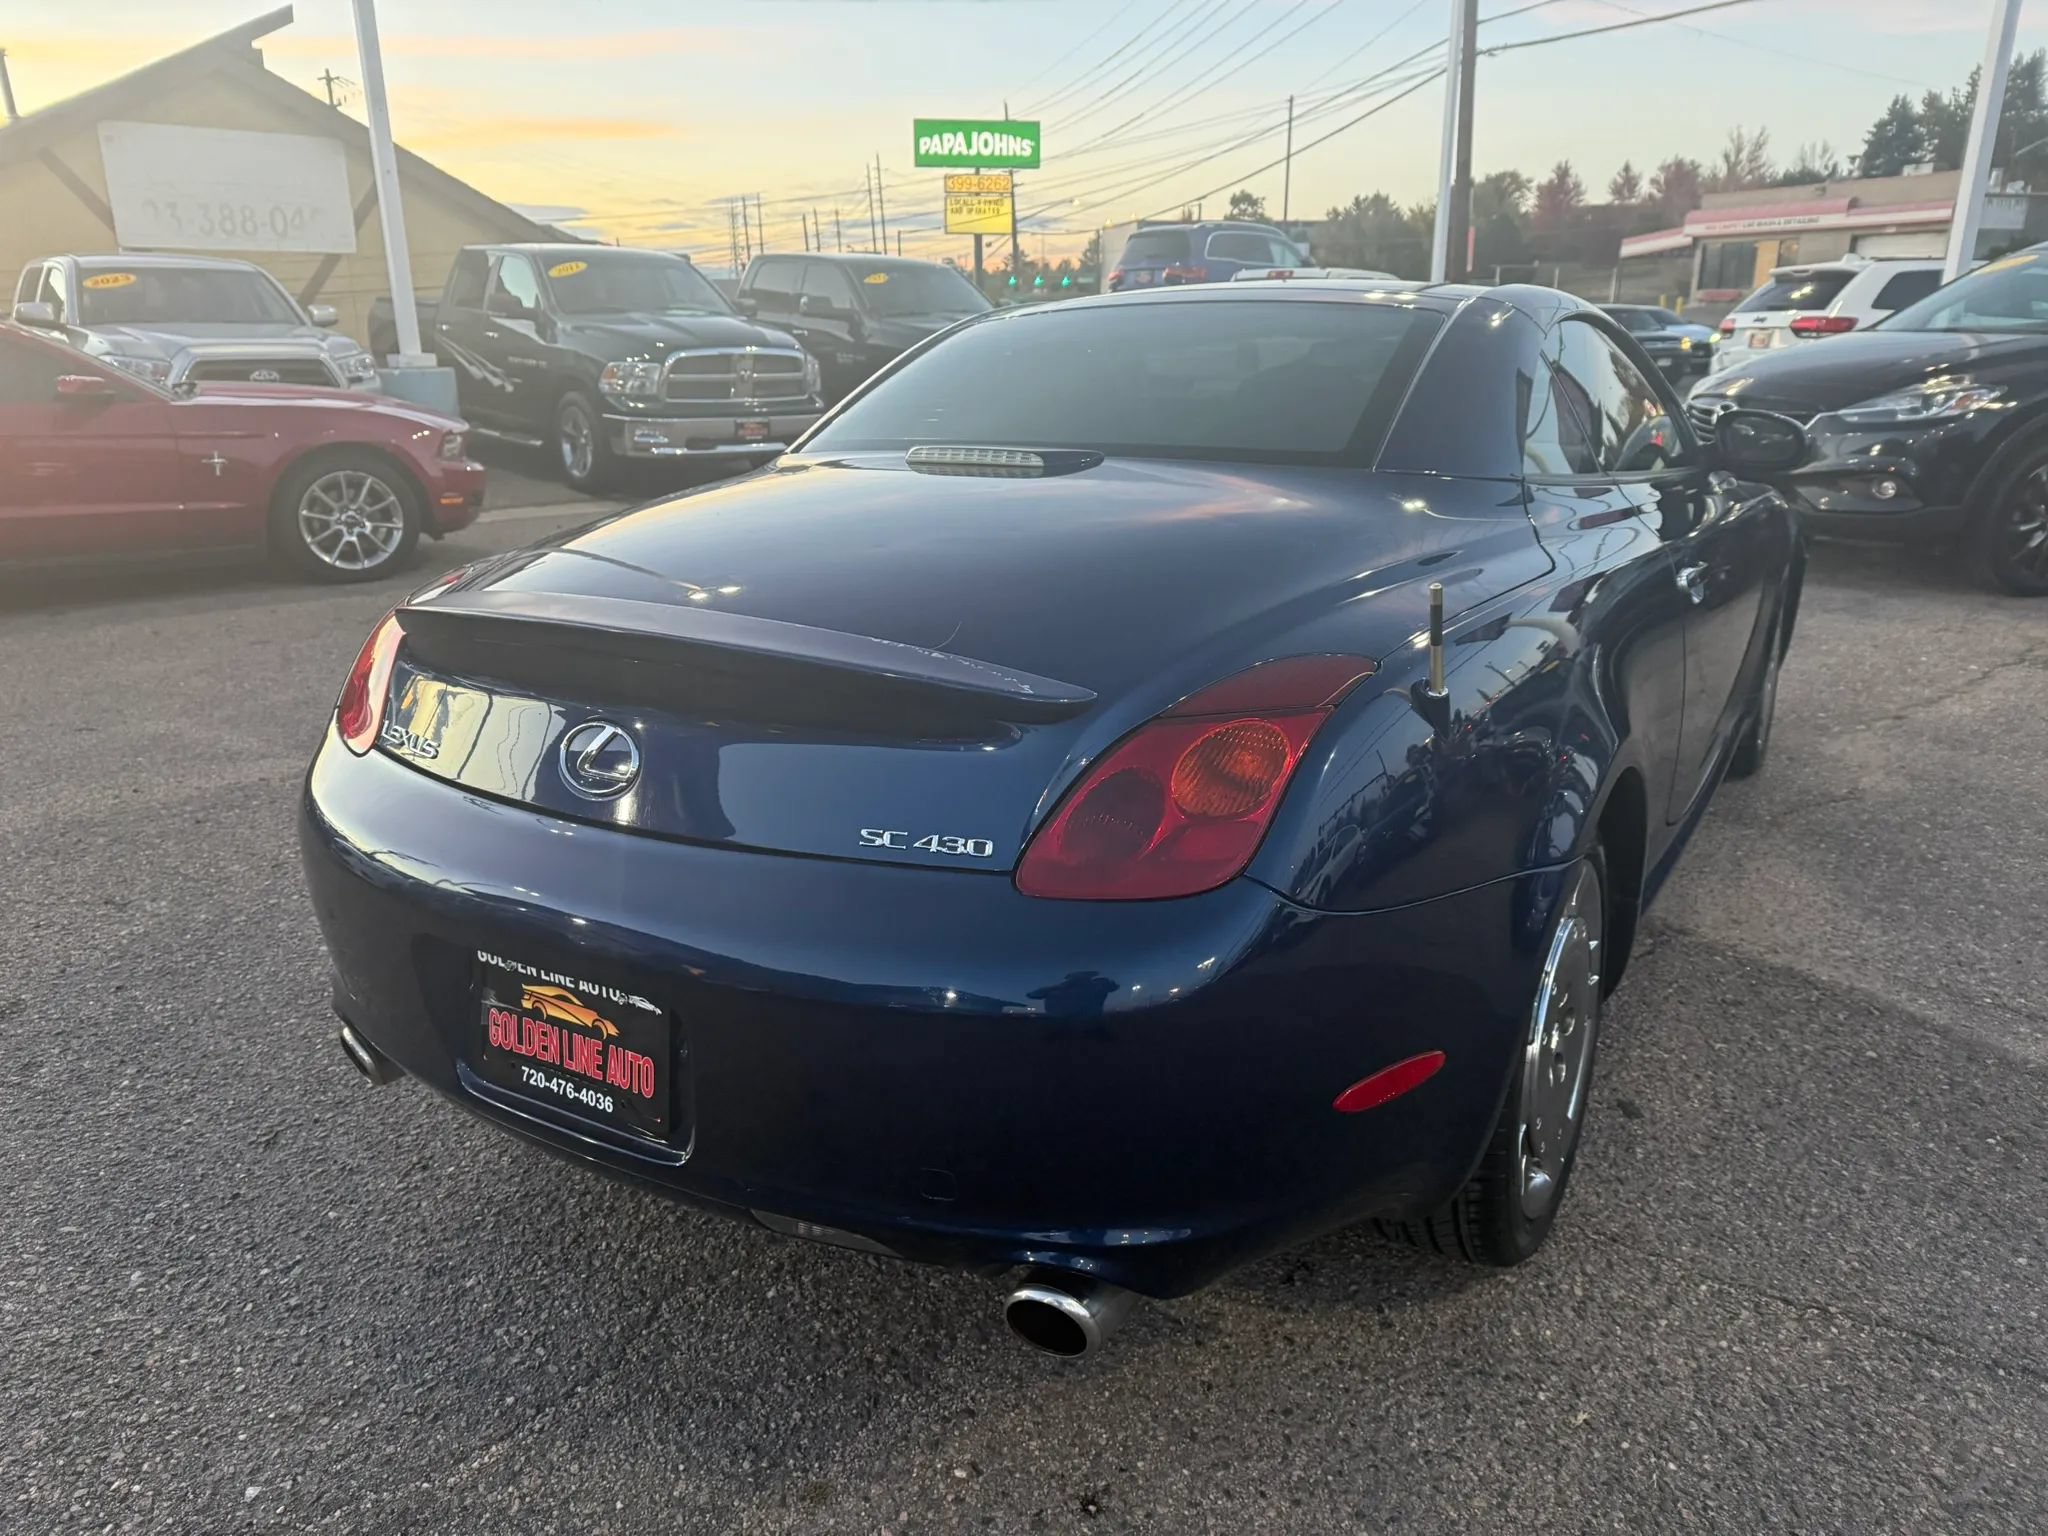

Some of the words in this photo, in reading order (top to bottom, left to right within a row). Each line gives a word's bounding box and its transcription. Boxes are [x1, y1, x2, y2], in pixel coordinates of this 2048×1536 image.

[949, 176, 1009, 191] 399-6262
[381, 719, 441, 759] LEXUS
[859, 828, 908, 850] SC
[913, 834, 993, 857] 430
[488, 1008, 560, 1065] GOLDEN
[563, 1029, 603, 1081] LINE
[606, 1044, 655, 1098] AUTO
[521, 1066, 614, 1113] 720-476-4036
